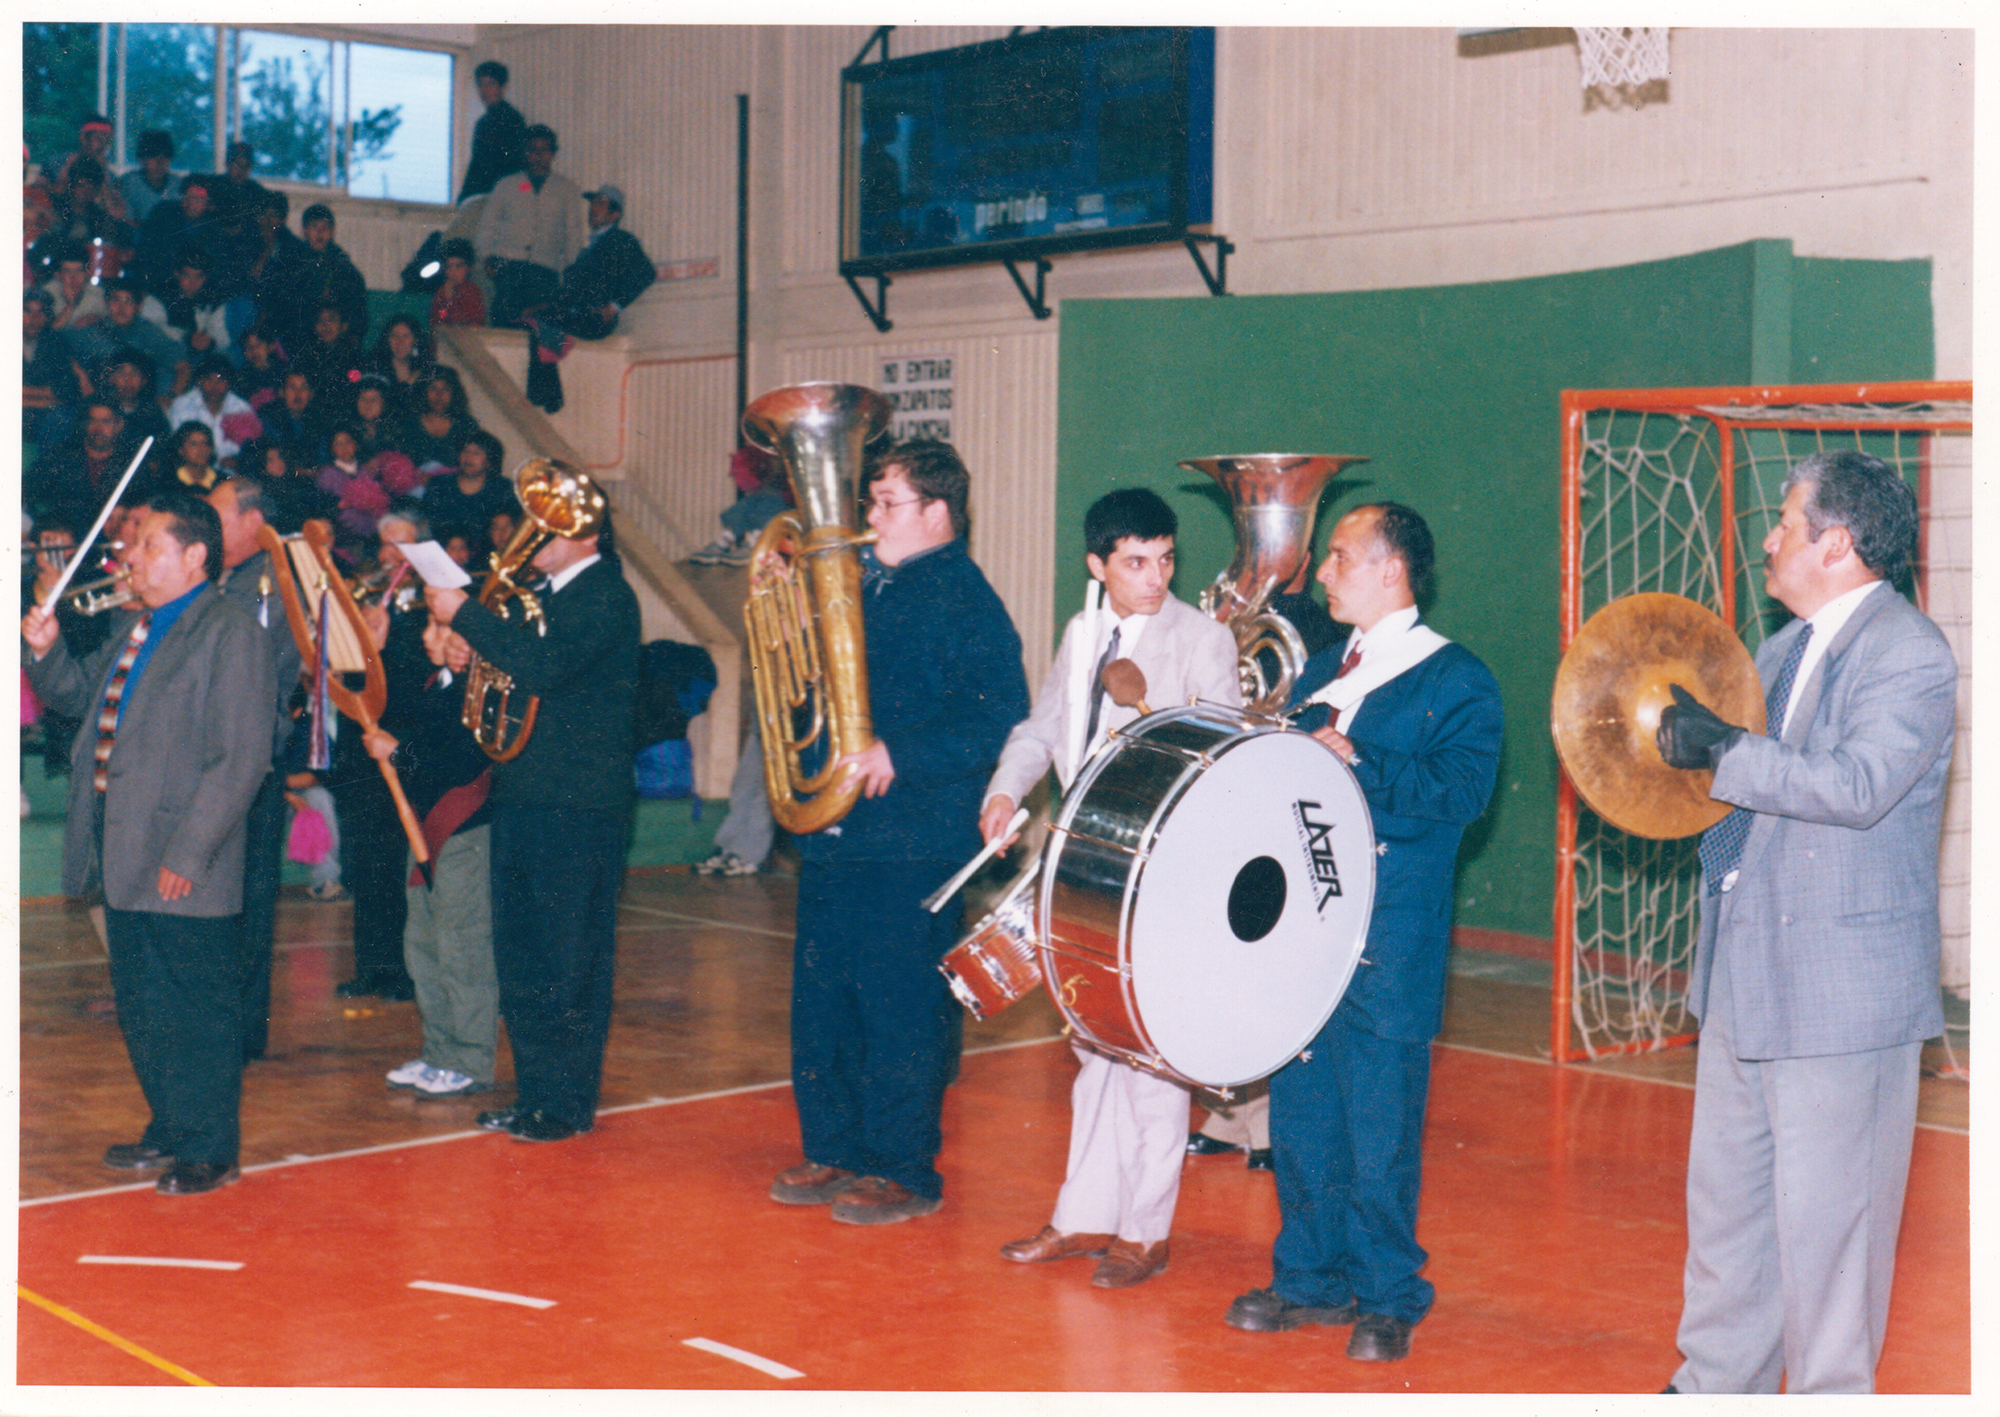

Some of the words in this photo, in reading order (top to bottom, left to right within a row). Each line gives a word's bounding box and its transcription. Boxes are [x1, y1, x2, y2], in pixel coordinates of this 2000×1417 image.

[975, 189, 1047, 235] periodo
[884, 363, 898, 383] NO
[906, 359, 952, 383] ENTRAR
[1291, 801, 1306, 840] MUSICAL
[1301, 842, 1321, 903] INSTRUMENTS
[1297, 798, 1343, 914] LAZER
